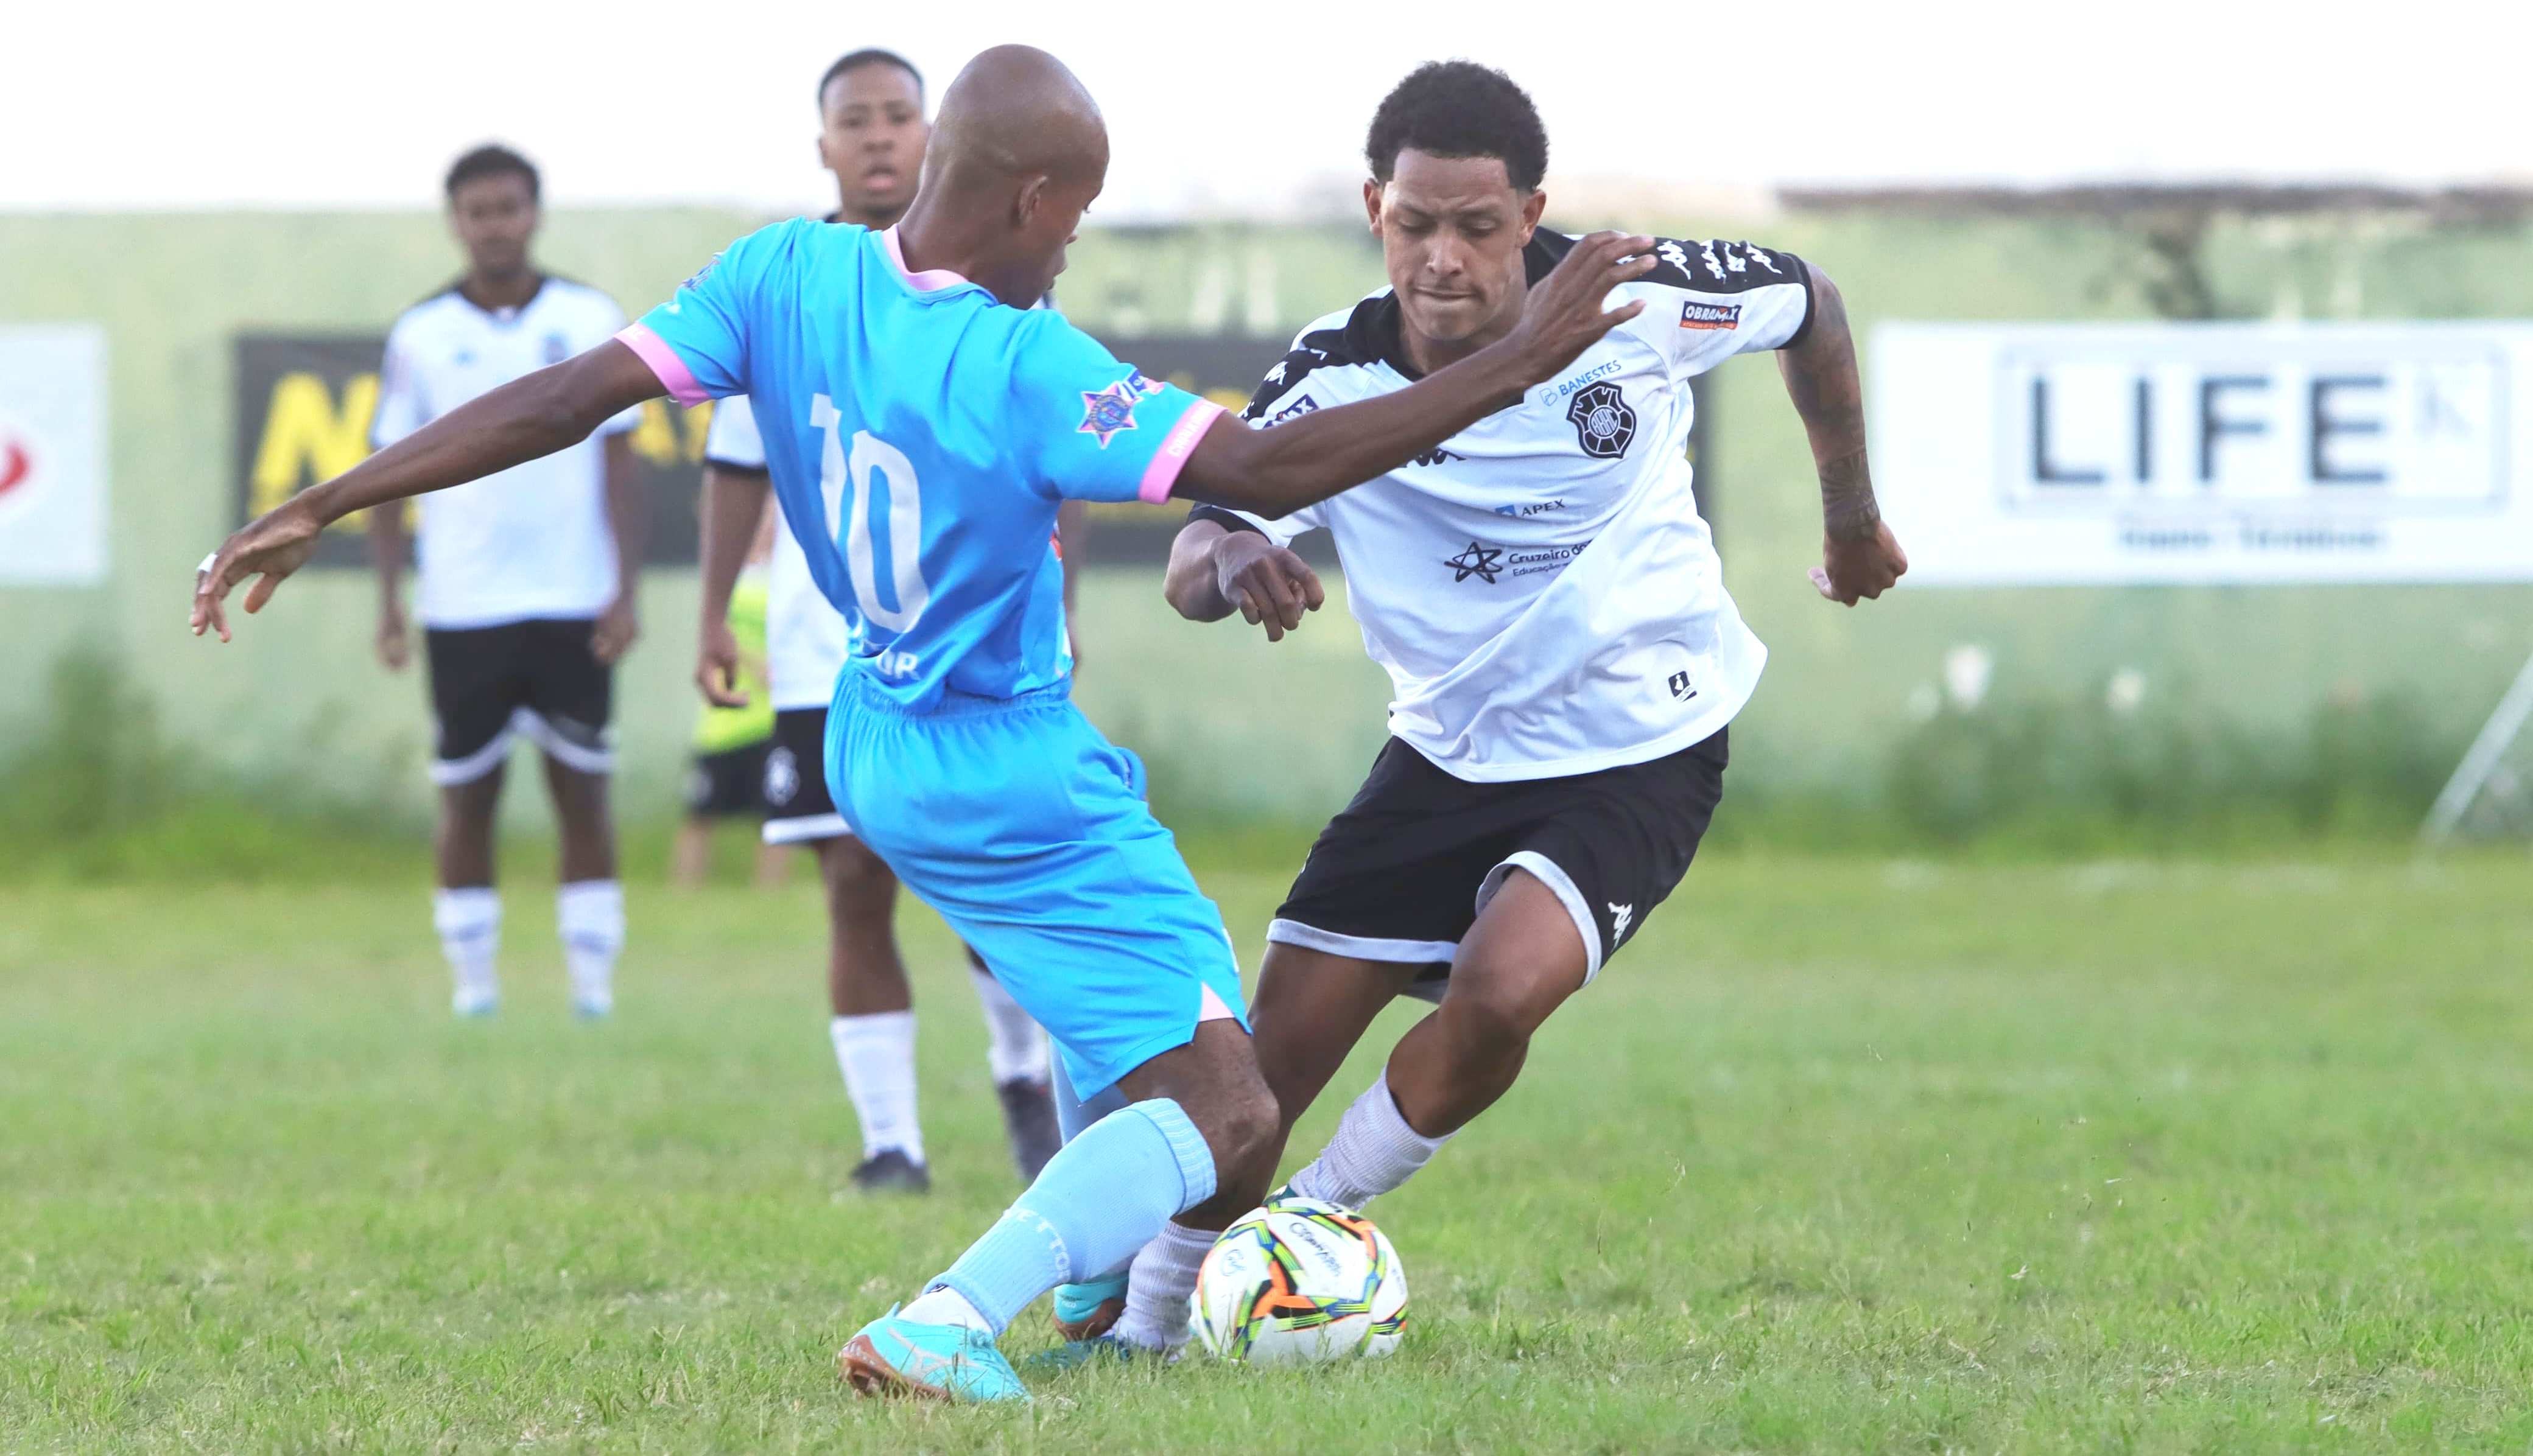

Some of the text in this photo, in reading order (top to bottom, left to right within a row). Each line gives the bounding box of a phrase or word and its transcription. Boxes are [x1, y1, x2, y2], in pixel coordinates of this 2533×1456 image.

[1558, 360, 1621, 396] BANESTES
[2032, 374, 2387, 485] LIFE
[809, 393, 930, 634] 10
[1522, 499, 1565, 516] APEX
[1508, 548, 1570, 564] Cruzeiro
